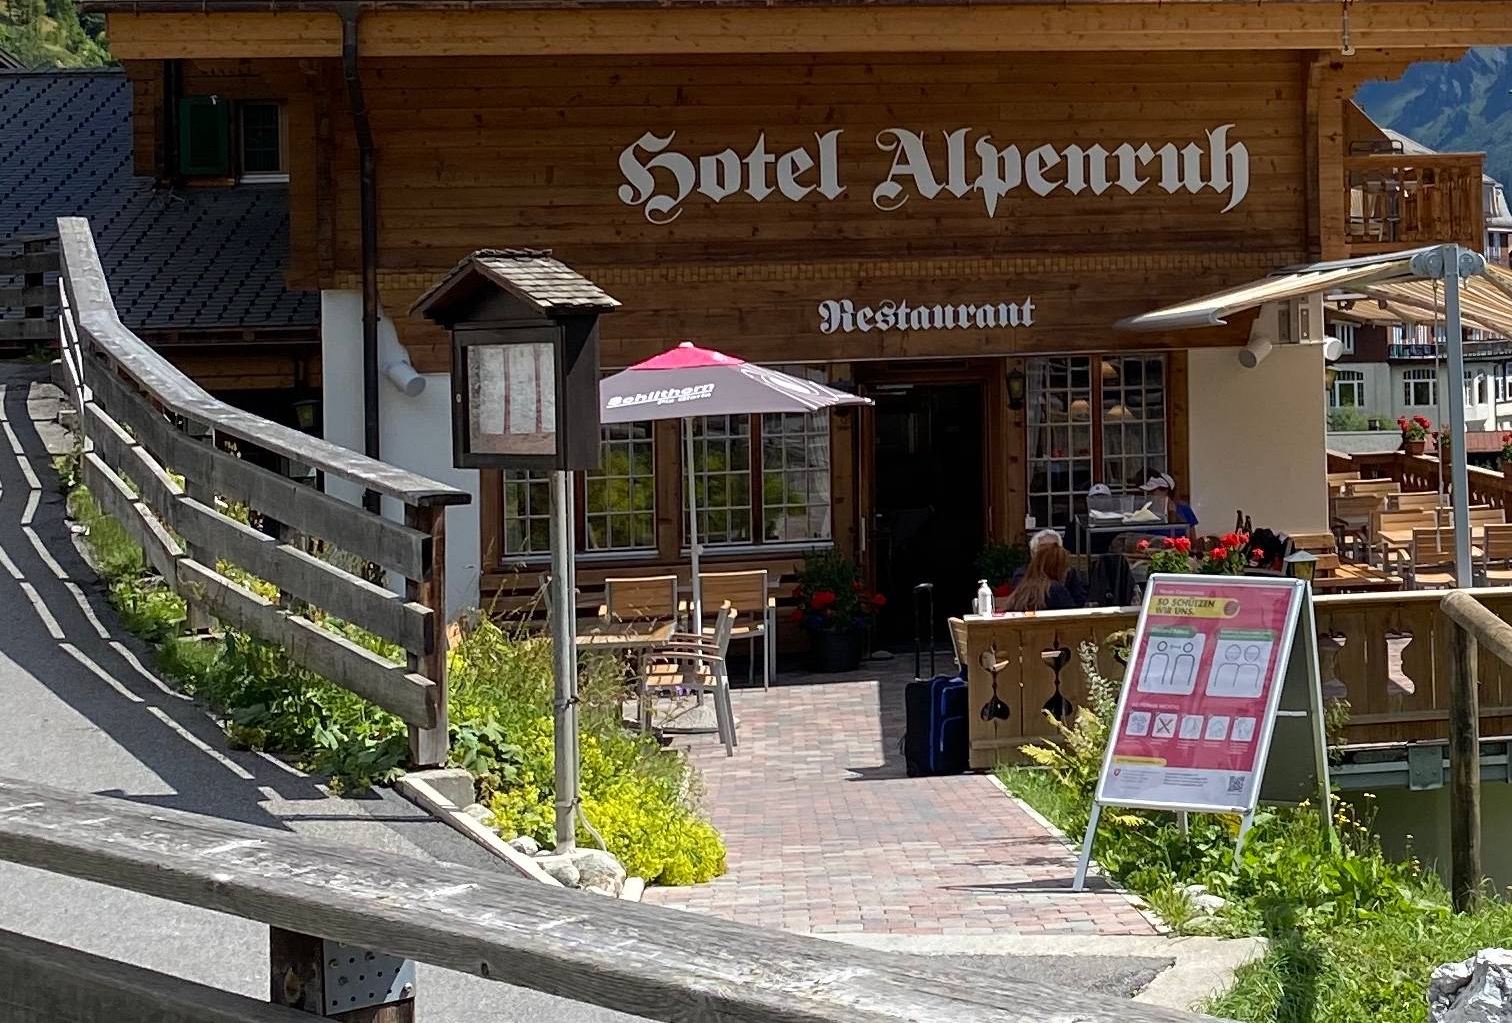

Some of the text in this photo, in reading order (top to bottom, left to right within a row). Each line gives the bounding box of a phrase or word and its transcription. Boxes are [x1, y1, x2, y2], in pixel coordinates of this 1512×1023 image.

[618, 124, 1251, 224] Hotel Alpenruh
[818, 295, 1036, 334] Restaurant
[1157, 597, 1216, 608] SO SCHÜTZEN
